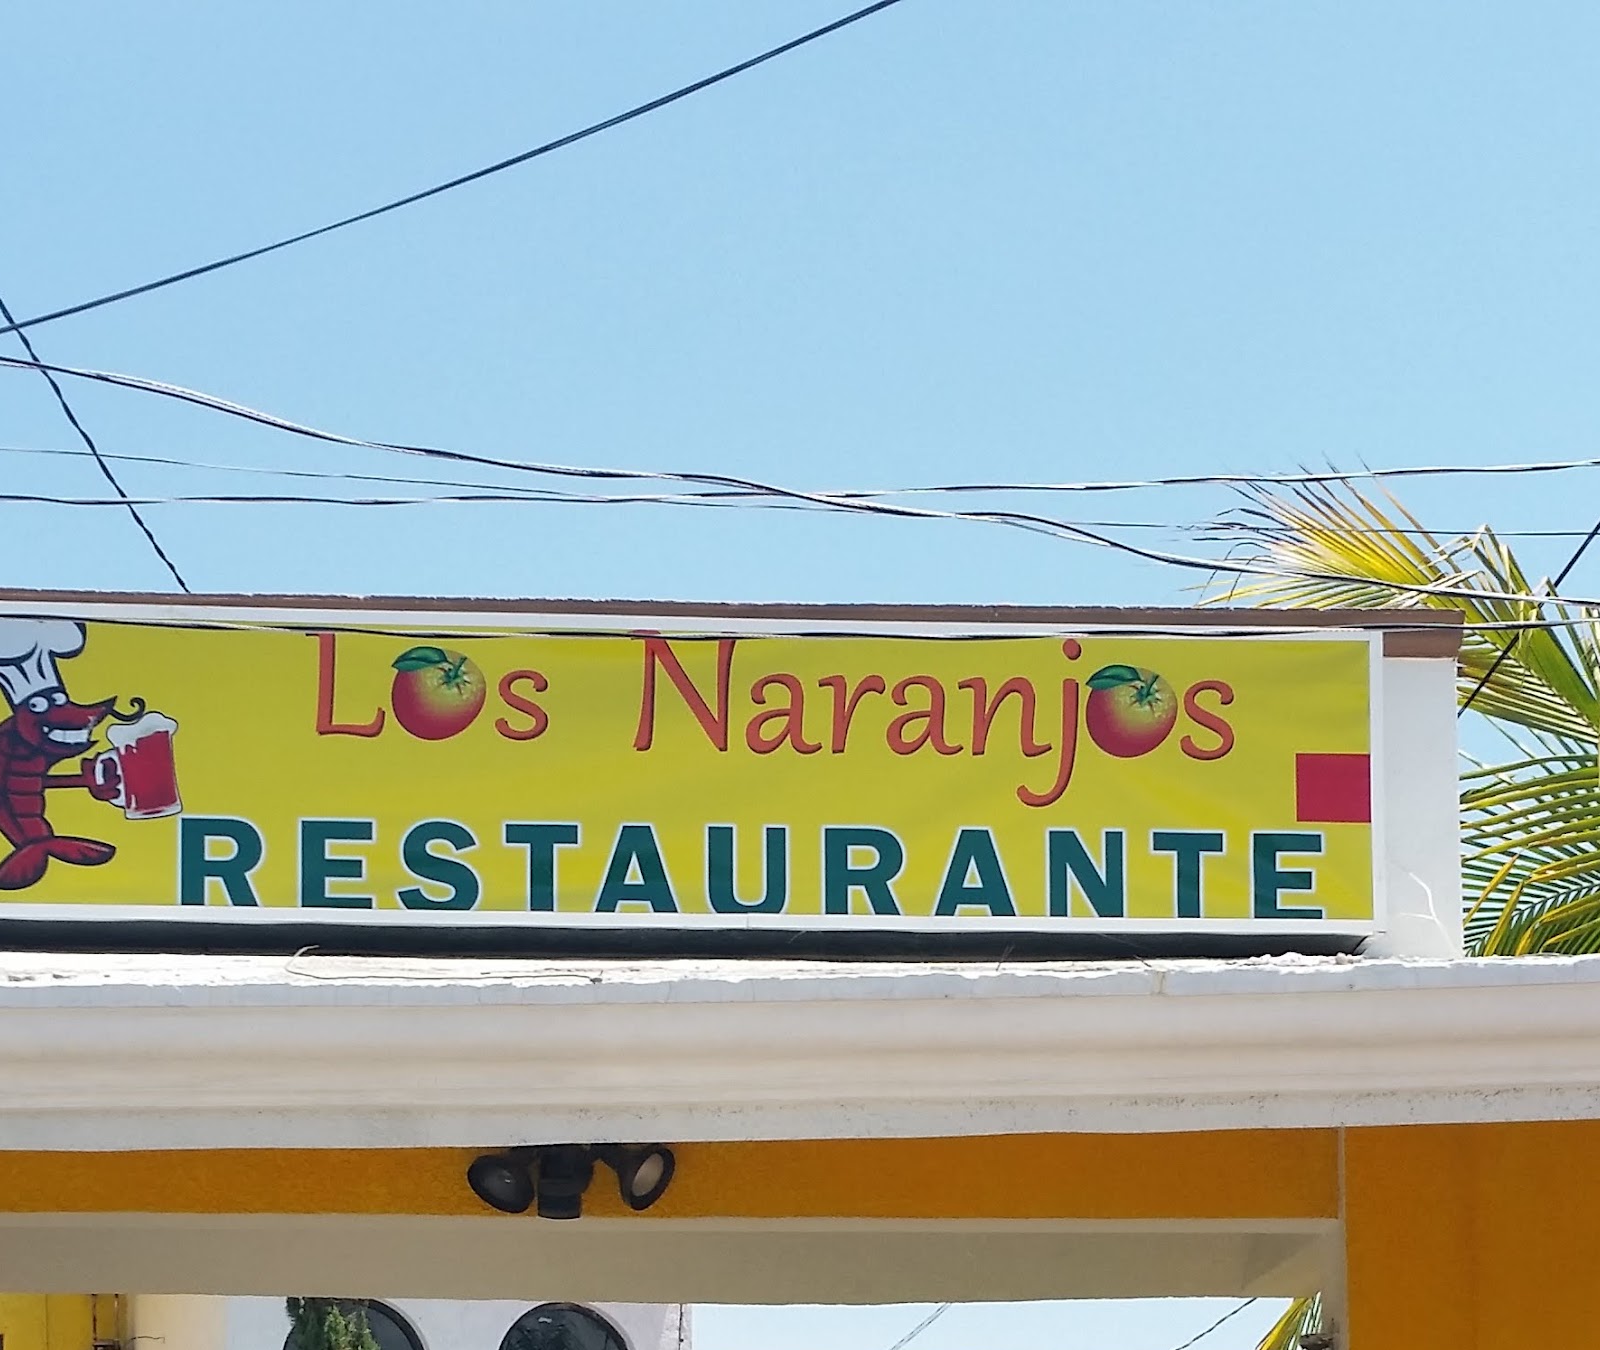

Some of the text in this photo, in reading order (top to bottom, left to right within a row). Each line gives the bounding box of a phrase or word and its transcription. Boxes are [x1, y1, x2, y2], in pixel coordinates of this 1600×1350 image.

[306, 630, 1235, 808] Los Naranjos
[179, 816, 1325, 919] RESTAURANTE
